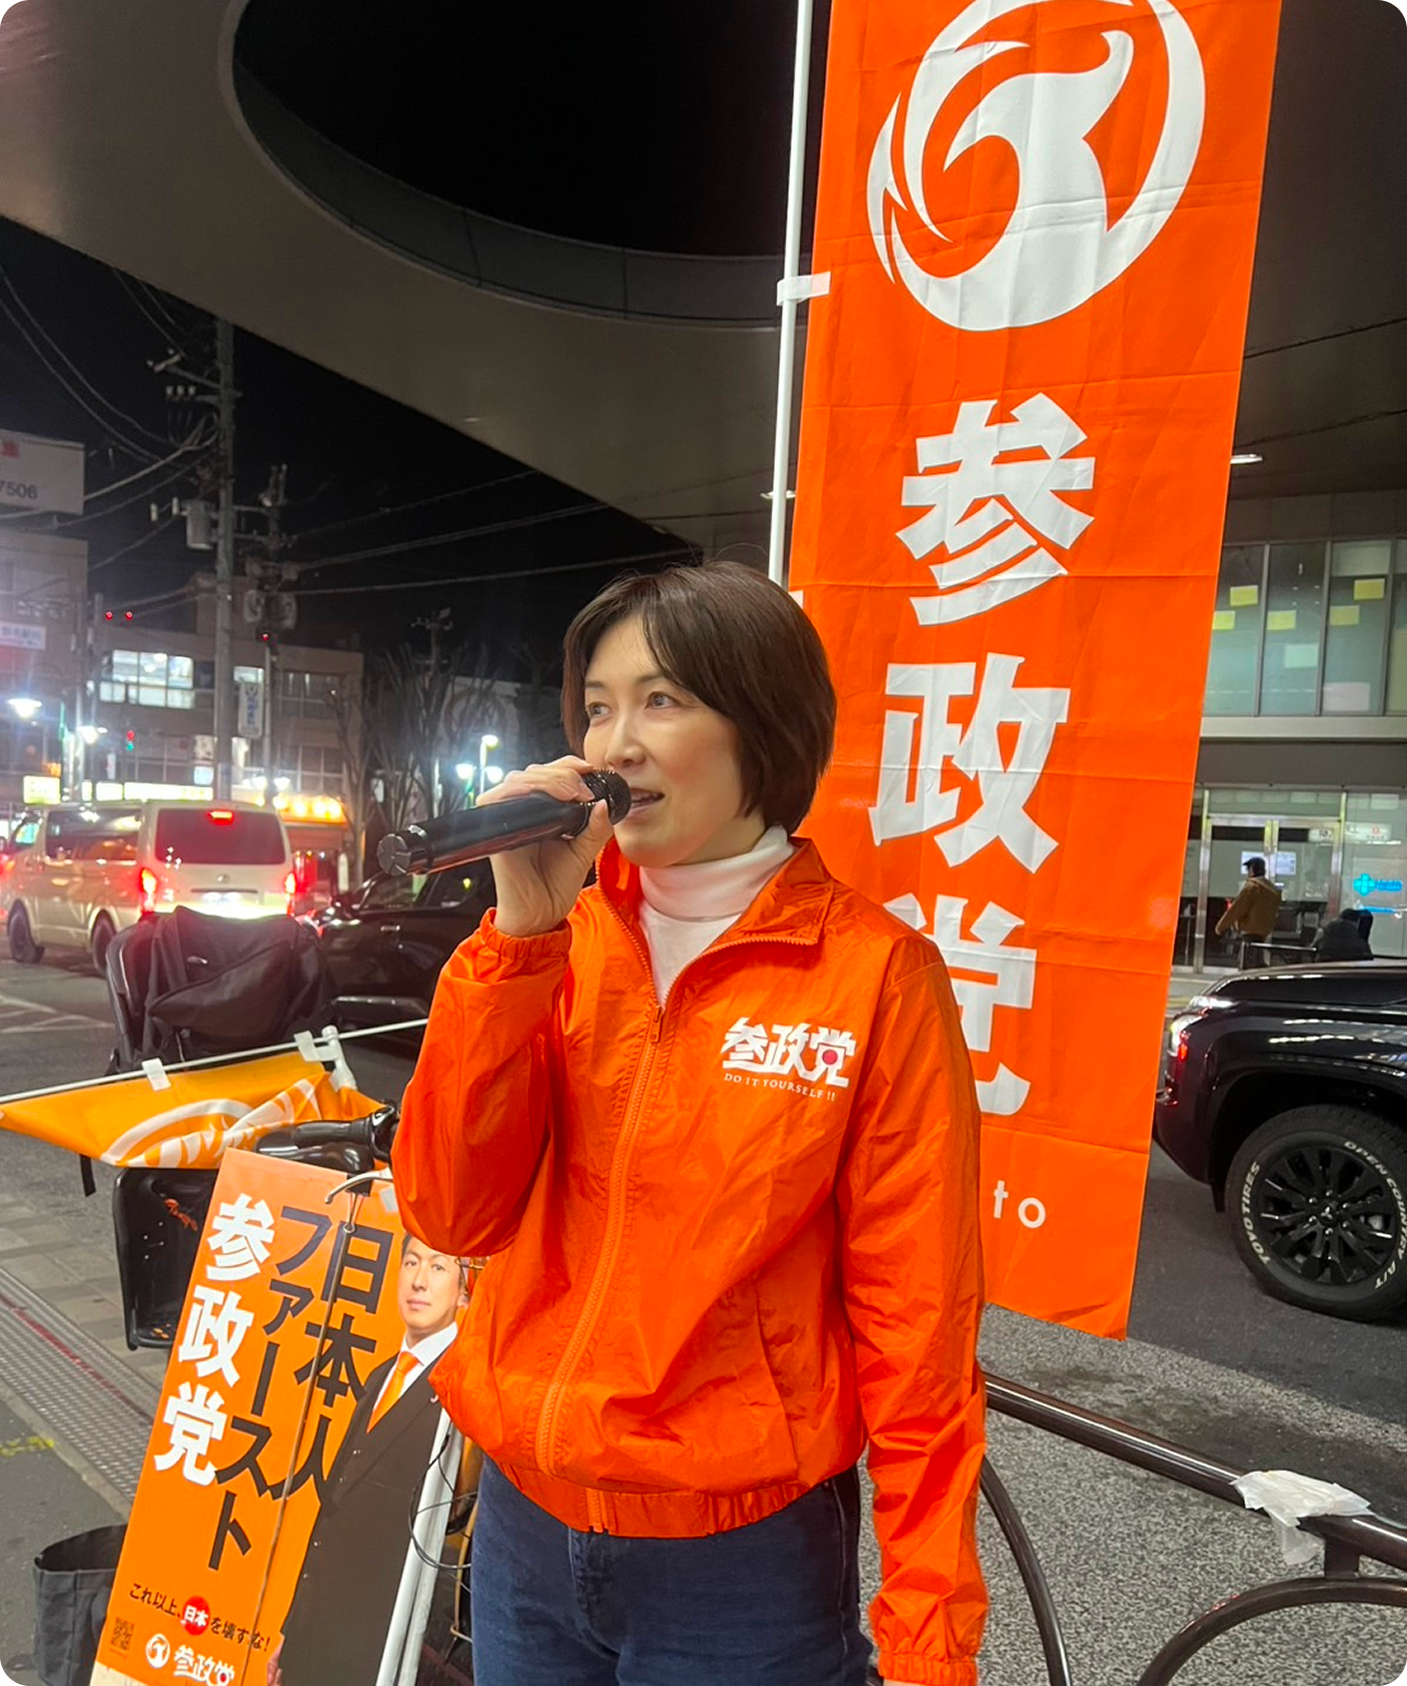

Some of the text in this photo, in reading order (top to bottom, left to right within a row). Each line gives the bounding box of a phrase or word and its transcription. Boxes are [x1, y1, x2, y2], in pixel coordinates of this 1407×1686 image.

[720, 1016, 856, 1088] 参政党
[724, 1073, 742, 1083] DO
[763, 1079, 824, 1098] YOURSELF
[1241, 1161, 1271, 1265] TOYO TIRES
[1344, 1141, 1388, 1175] OPEN
[1375, 1260, 1397, 1289] A/T
[153, 1193, 275, 1487] 参政党
[208, 1205, 333, 1571] ファースト
[267, 1221, 394, 1506] 日本人
[173, 1645, 236, 1686] 参政党
